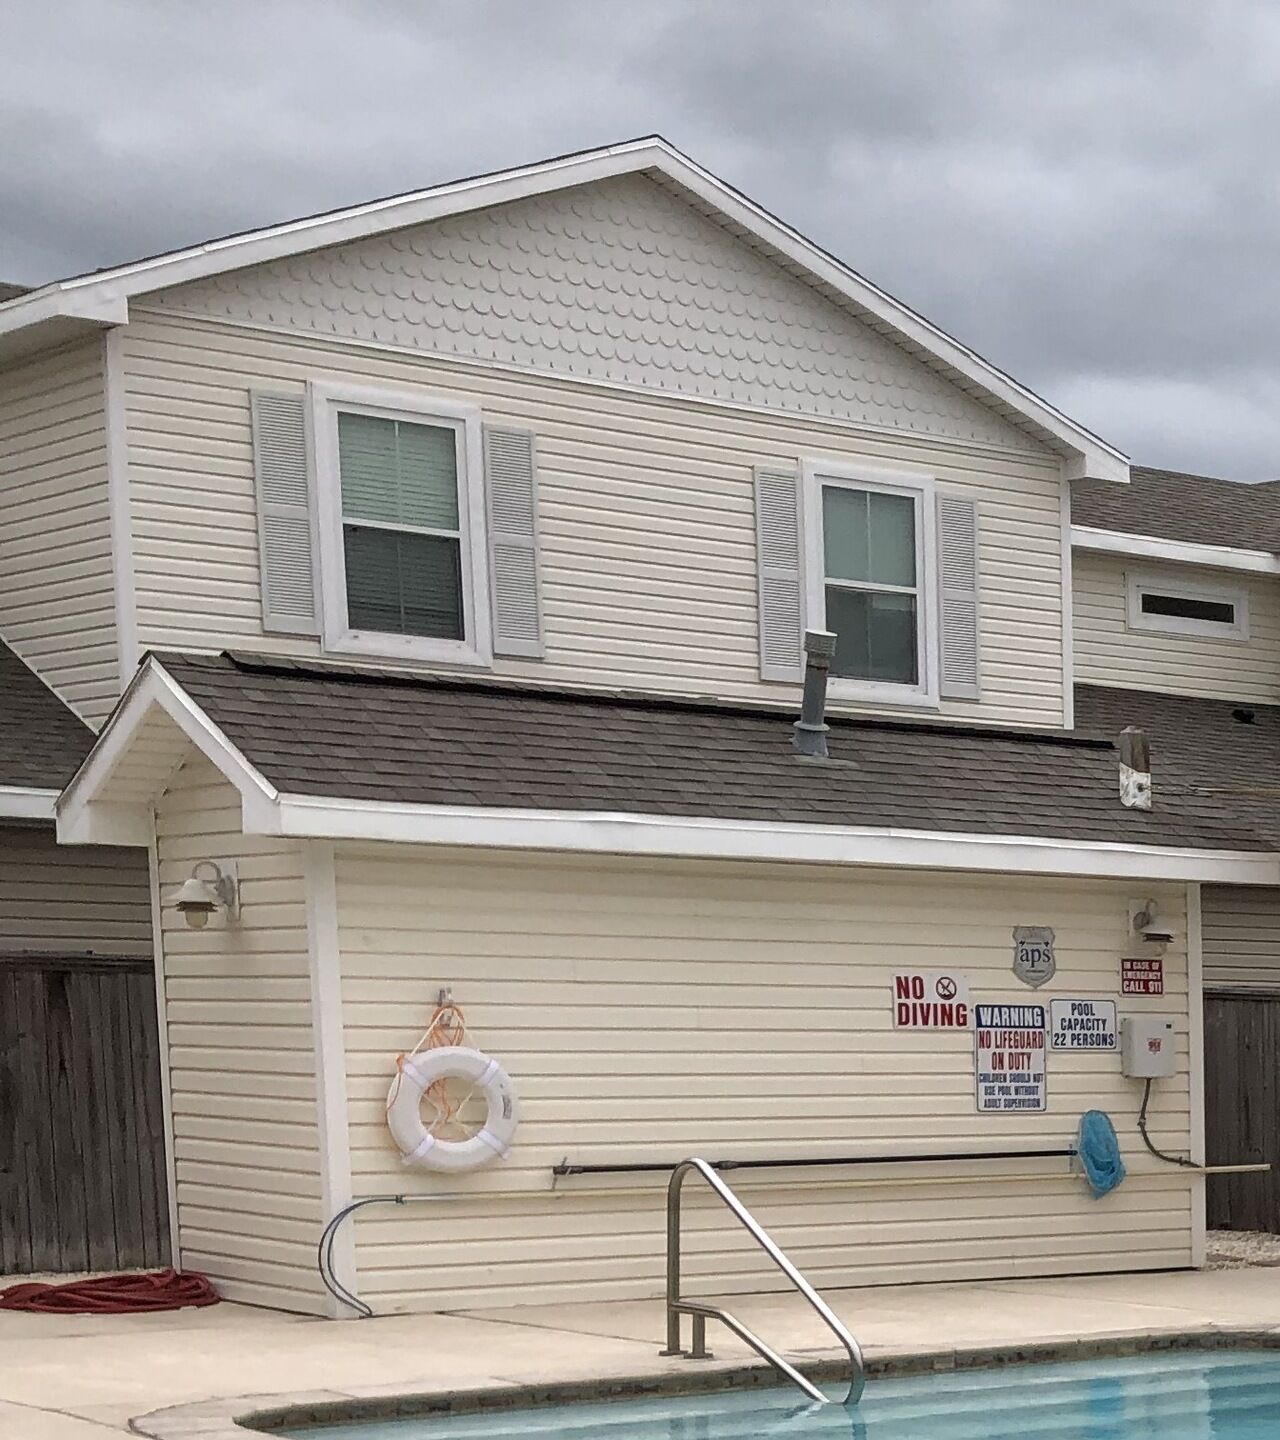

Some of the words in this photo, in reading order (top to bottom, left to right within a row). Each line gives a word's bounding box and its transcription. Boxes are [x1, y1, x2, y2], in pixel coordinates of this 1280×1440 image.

[1020, 947, 1051, 968] aps
[1124, 961, 1132, 970] IN
[1133, 961, 1150, 970] CASE
[1123, 970, 1161, 980] EMERGENCY
[895, 975, 925, 1000] NO
[1123, 981, 1145, 992] CALL
[1149, 981, 1162, 993] 911
[897, 1002, 968, 1027] DIVING
[1071, 1002, 1096, 1016] POOL
[979, 1007, 1042, 1027] WARNING
[1060, 1017, 1107, 1031] CAPACITY
[979, 1030, 991, 1049] NO
[995, 1030, 1044, 1049] LIFEGUARD
[1054, 1033, 1066, 1046] 22
[1070, 1033, 1114, 1046] PERSONS
[991, 1052, 1004, 1071] ON
[1008, 1052, 1032, 1071] DUTY
[979, 1073, 1007, 1083] CHILDREN
[1009, 1073, 1031, 1083] SHOULD
[1032, 1073, 1044, 1083] NOT
[997, 1086, 1012, 1096] POOL
[1014, 1086, 1039, 1096] WITHOUT
[984, 1098, 1001, 1108] ADULT
[1003, 1098, 1041, 1108] SUPERVISION
